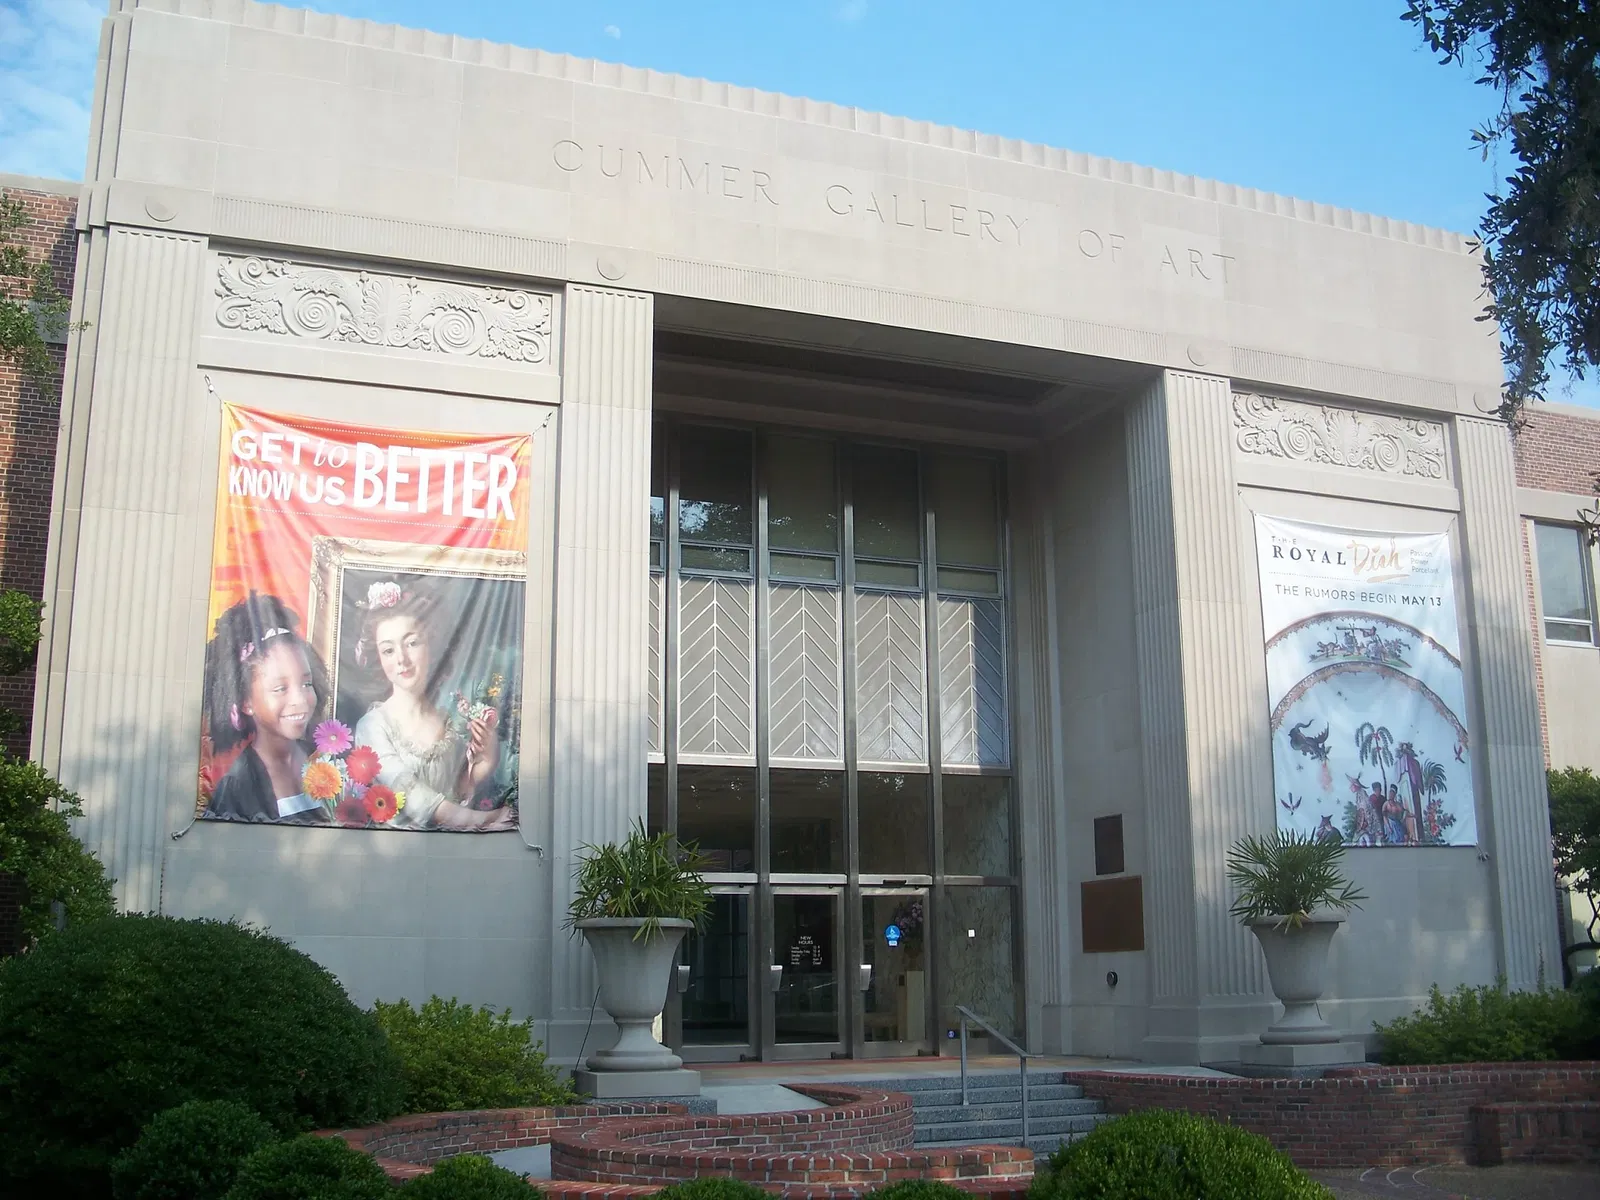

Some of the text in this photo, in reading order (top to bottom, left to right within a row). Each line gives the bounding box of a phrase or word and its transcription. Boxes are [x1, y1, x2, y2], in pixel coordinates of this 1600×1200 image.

[553, 140, 1236, 283] CUMMER GALLERY OF ART
[231, 429, 349, 468] GET to
[228, 465, 346, 507] KNOW US
[353, 442, 518, 521] BETTER
[1272, 544, 1347, 566] ROYAL
[1275, 583, 1442, 607] THE RUMORS BEGIN MAY 13
